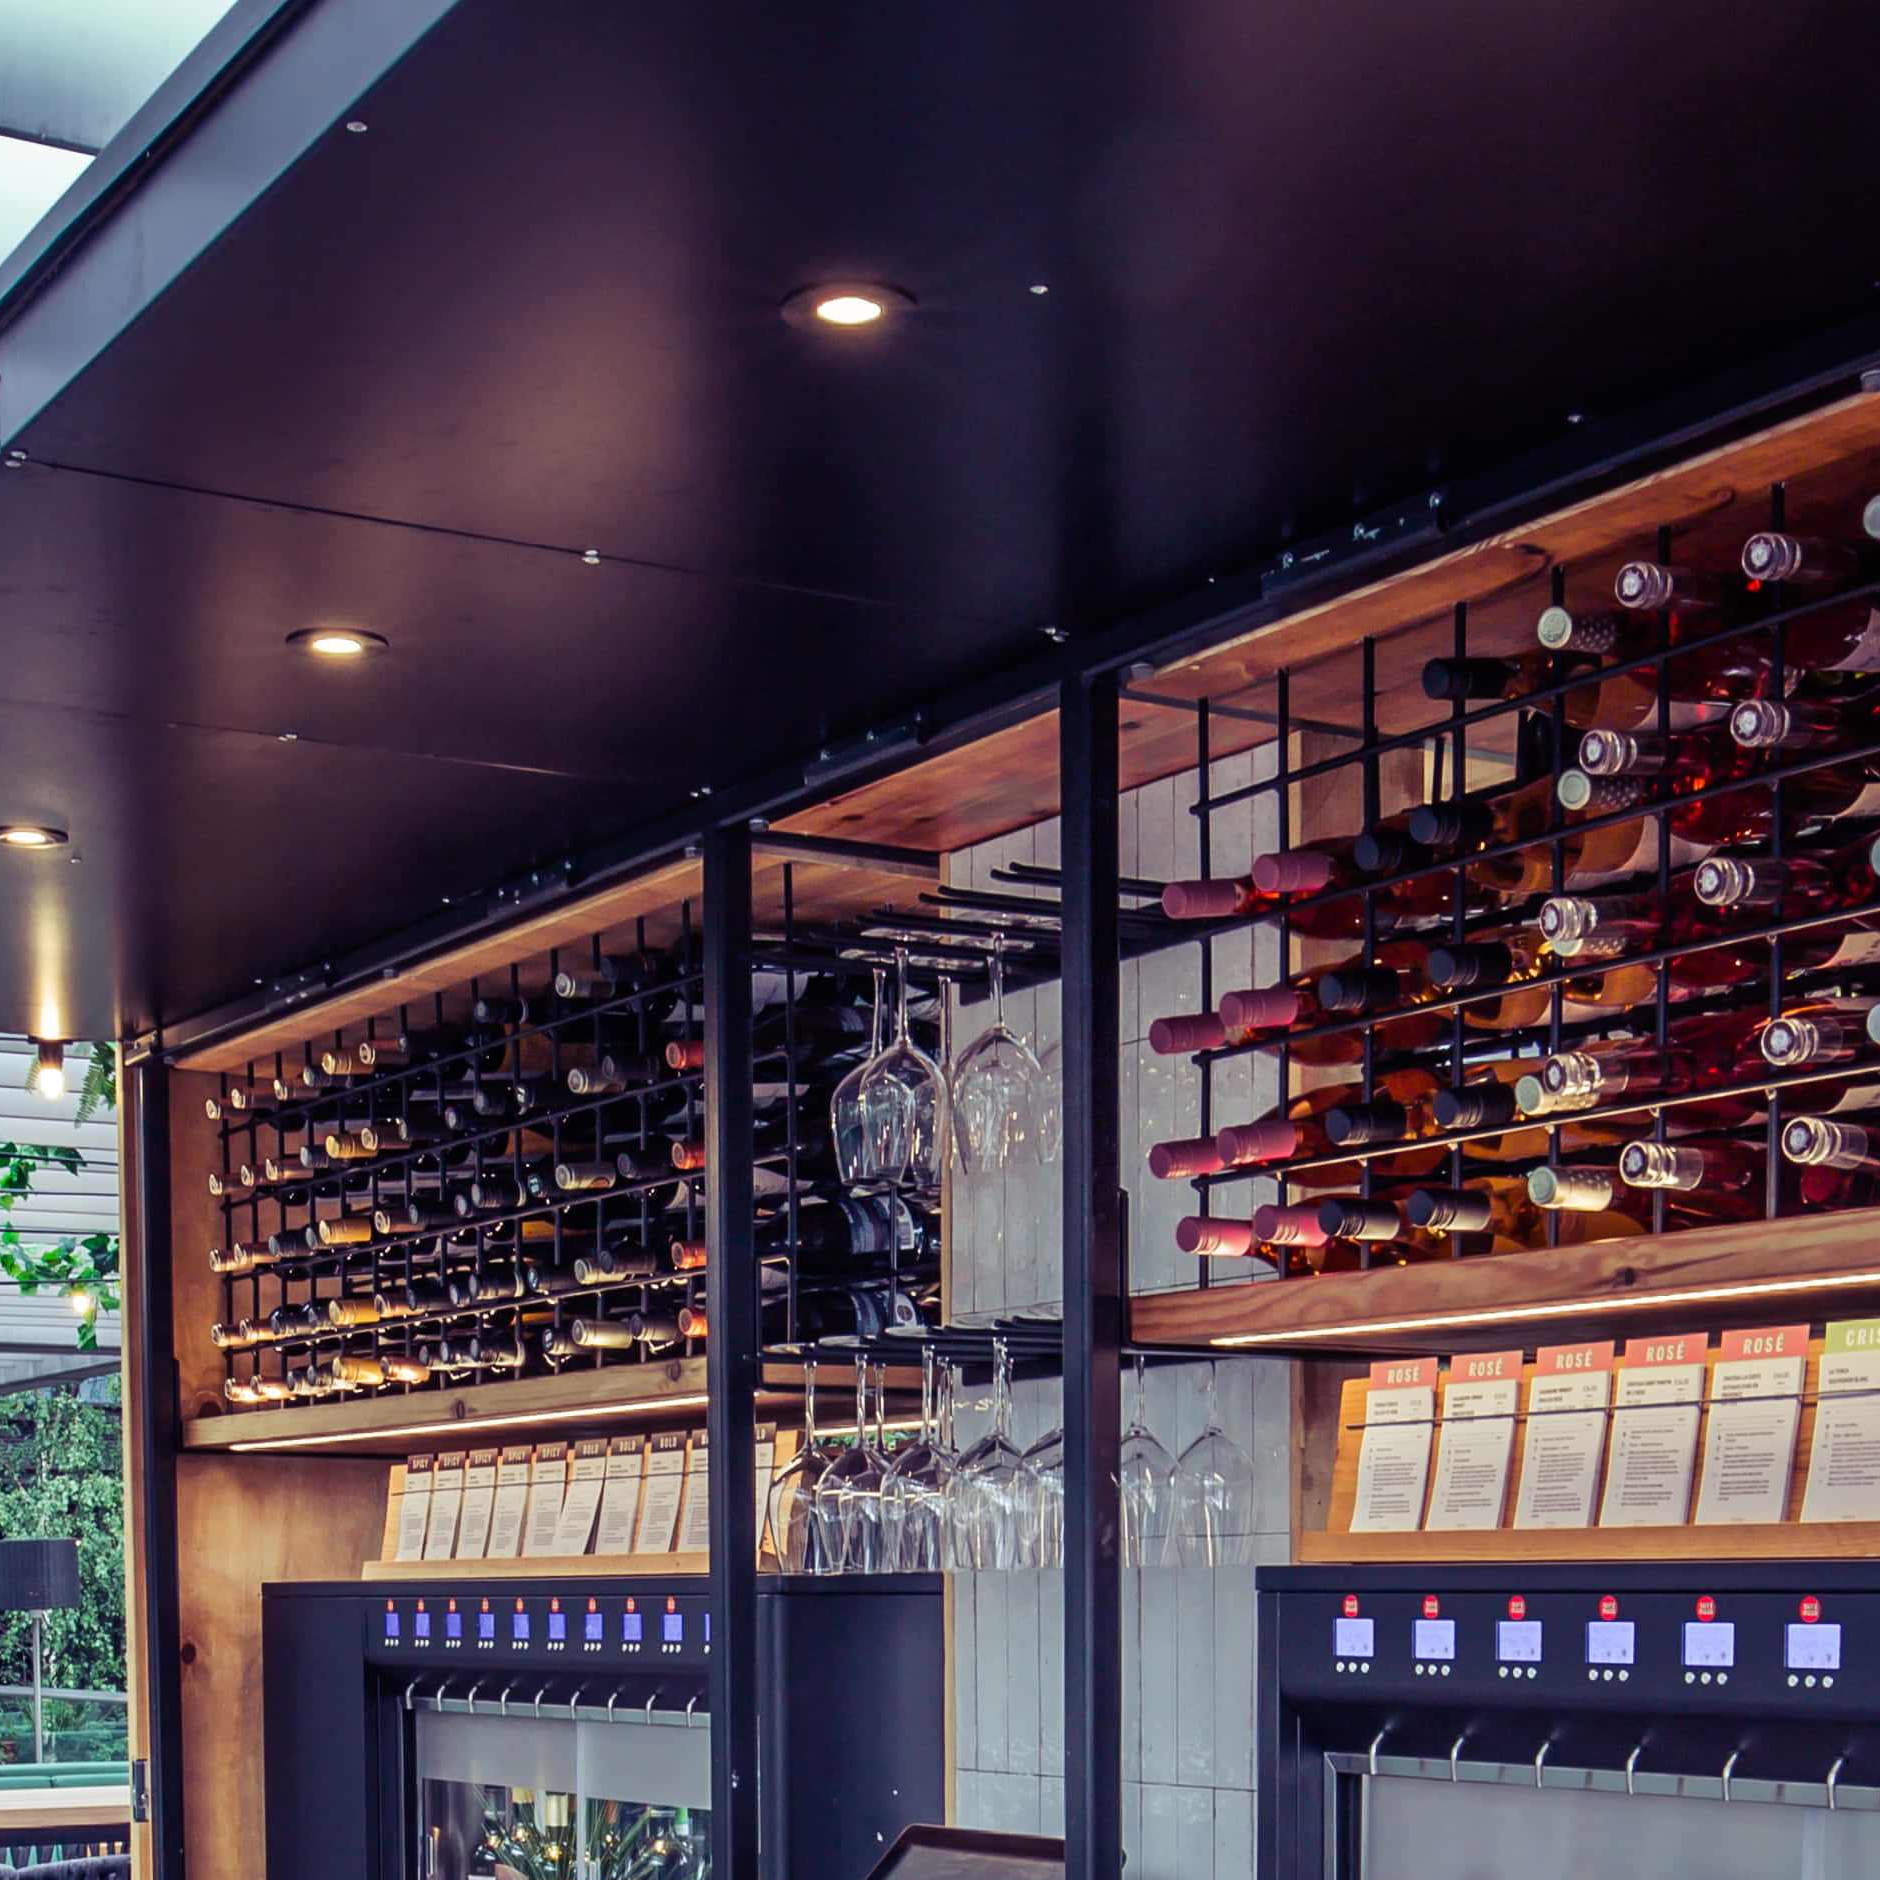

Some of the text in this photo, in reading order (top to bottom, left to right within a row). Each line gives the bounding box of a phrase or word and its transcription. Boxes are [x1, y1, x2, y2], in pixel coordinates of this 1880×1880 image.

[1646, 1341, 1687, 1363] ROSÉ
[1743, 1332, 1786, 1355] ROSÉ
[1468, 1357, 1504, 1377] ROSÉ
[1556, 1349, 1594, 1370] ROSÉ
[1387, 1365, 1421, 1384] ROSÉ
